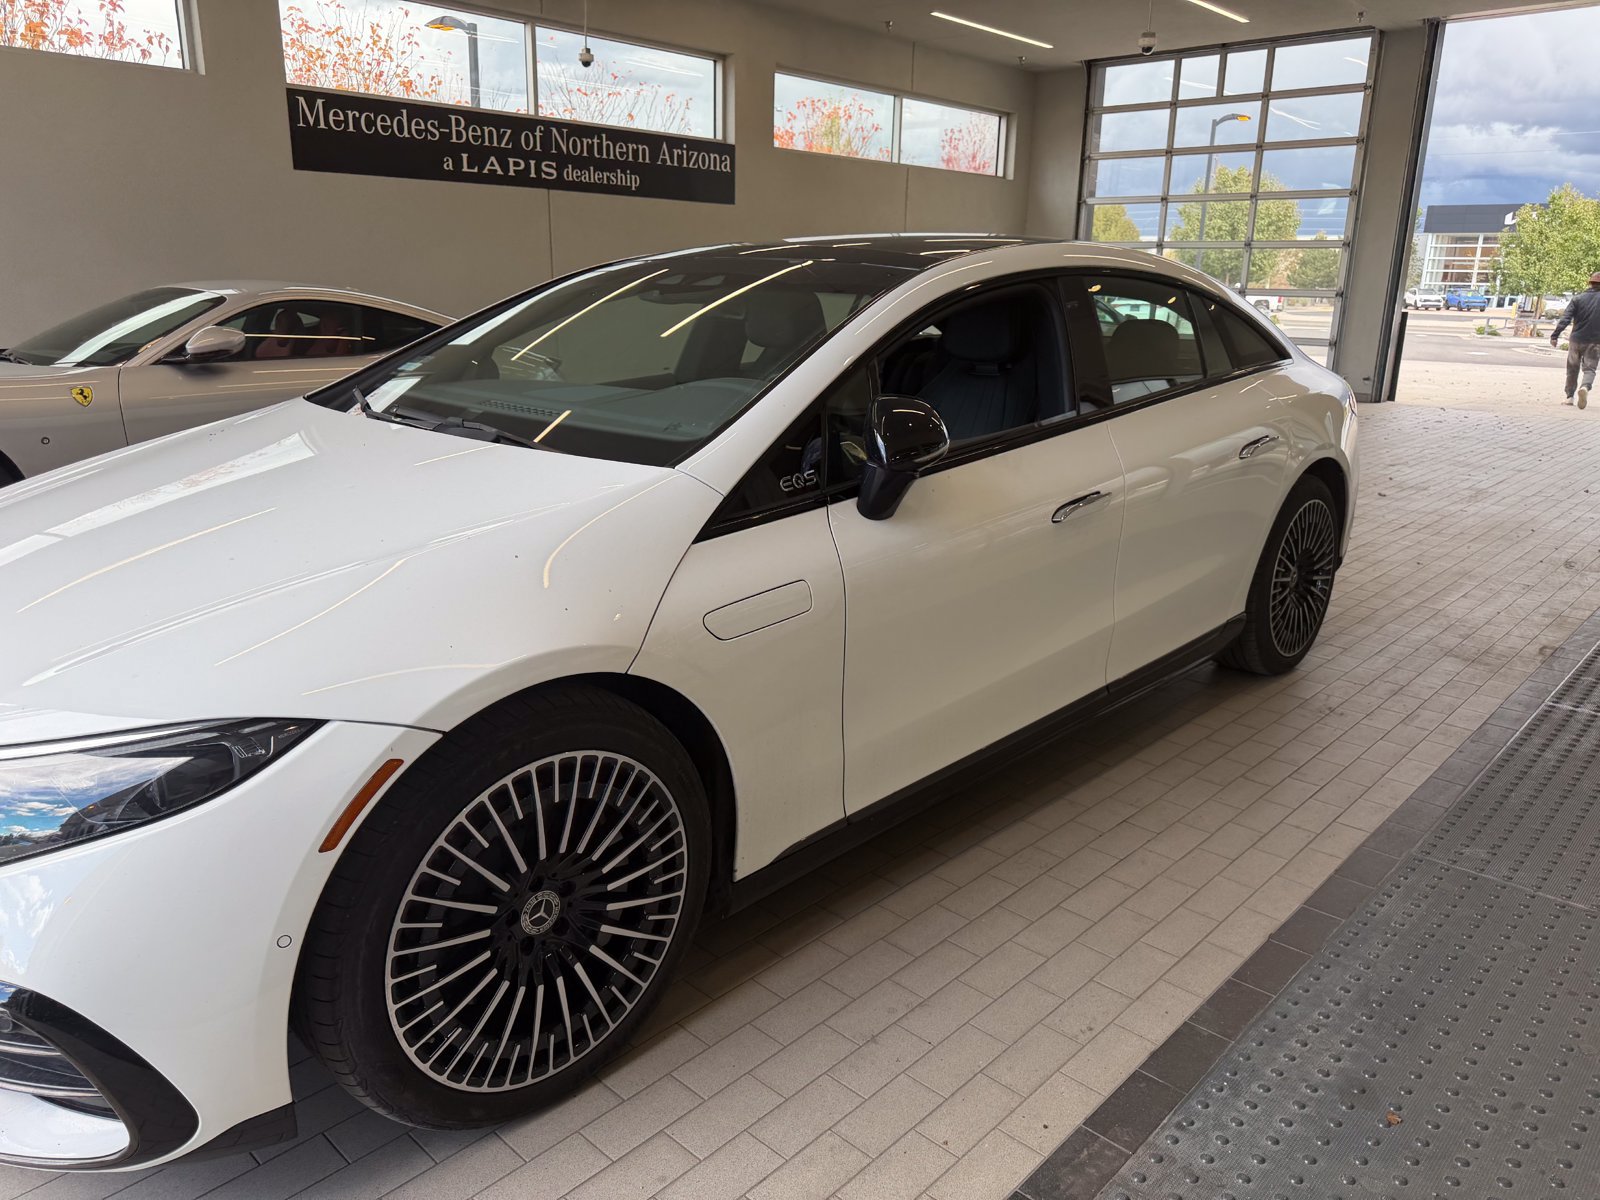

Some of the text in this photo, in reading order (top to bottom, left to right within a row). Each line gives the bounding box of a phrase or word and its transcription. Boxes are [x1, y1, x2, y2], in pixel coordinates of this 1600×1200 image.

[295, 96, 732, 173] Mercedes-Benz of Northern Arizona
[443, 153, 640, 190] a LAPIS dealership
[779, 470, 817, 492] EQS
